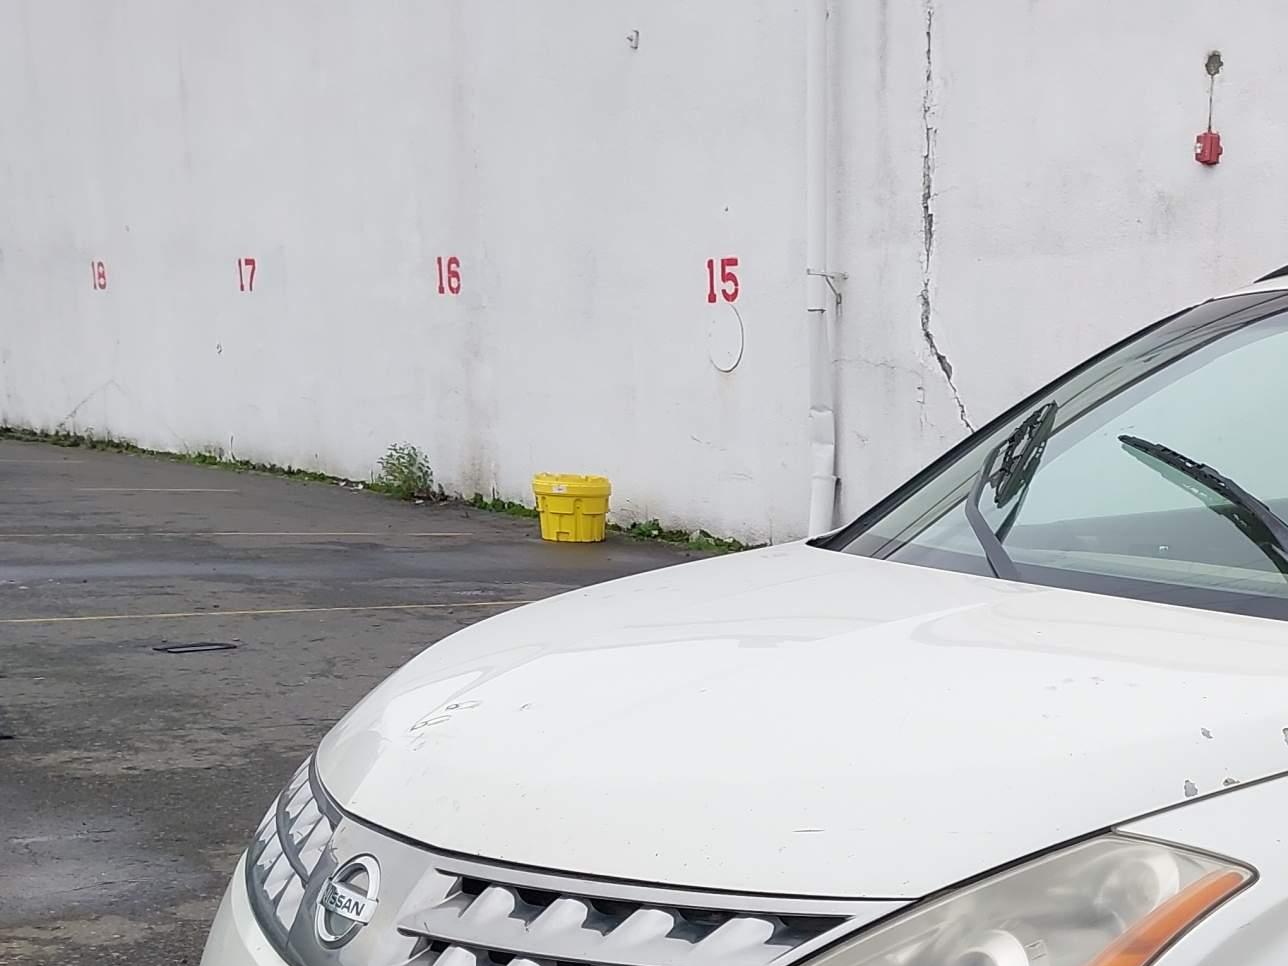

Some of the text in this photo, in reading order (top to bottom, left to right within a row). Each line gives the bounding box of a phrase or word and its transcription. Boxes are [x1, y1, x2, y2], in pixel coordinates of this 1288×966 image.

[91, 261, 107, 290] 18
[238, 258, 256, 292] 17
[436, 256, 461, 295] 16
[706, 256, 740, 304] 15
